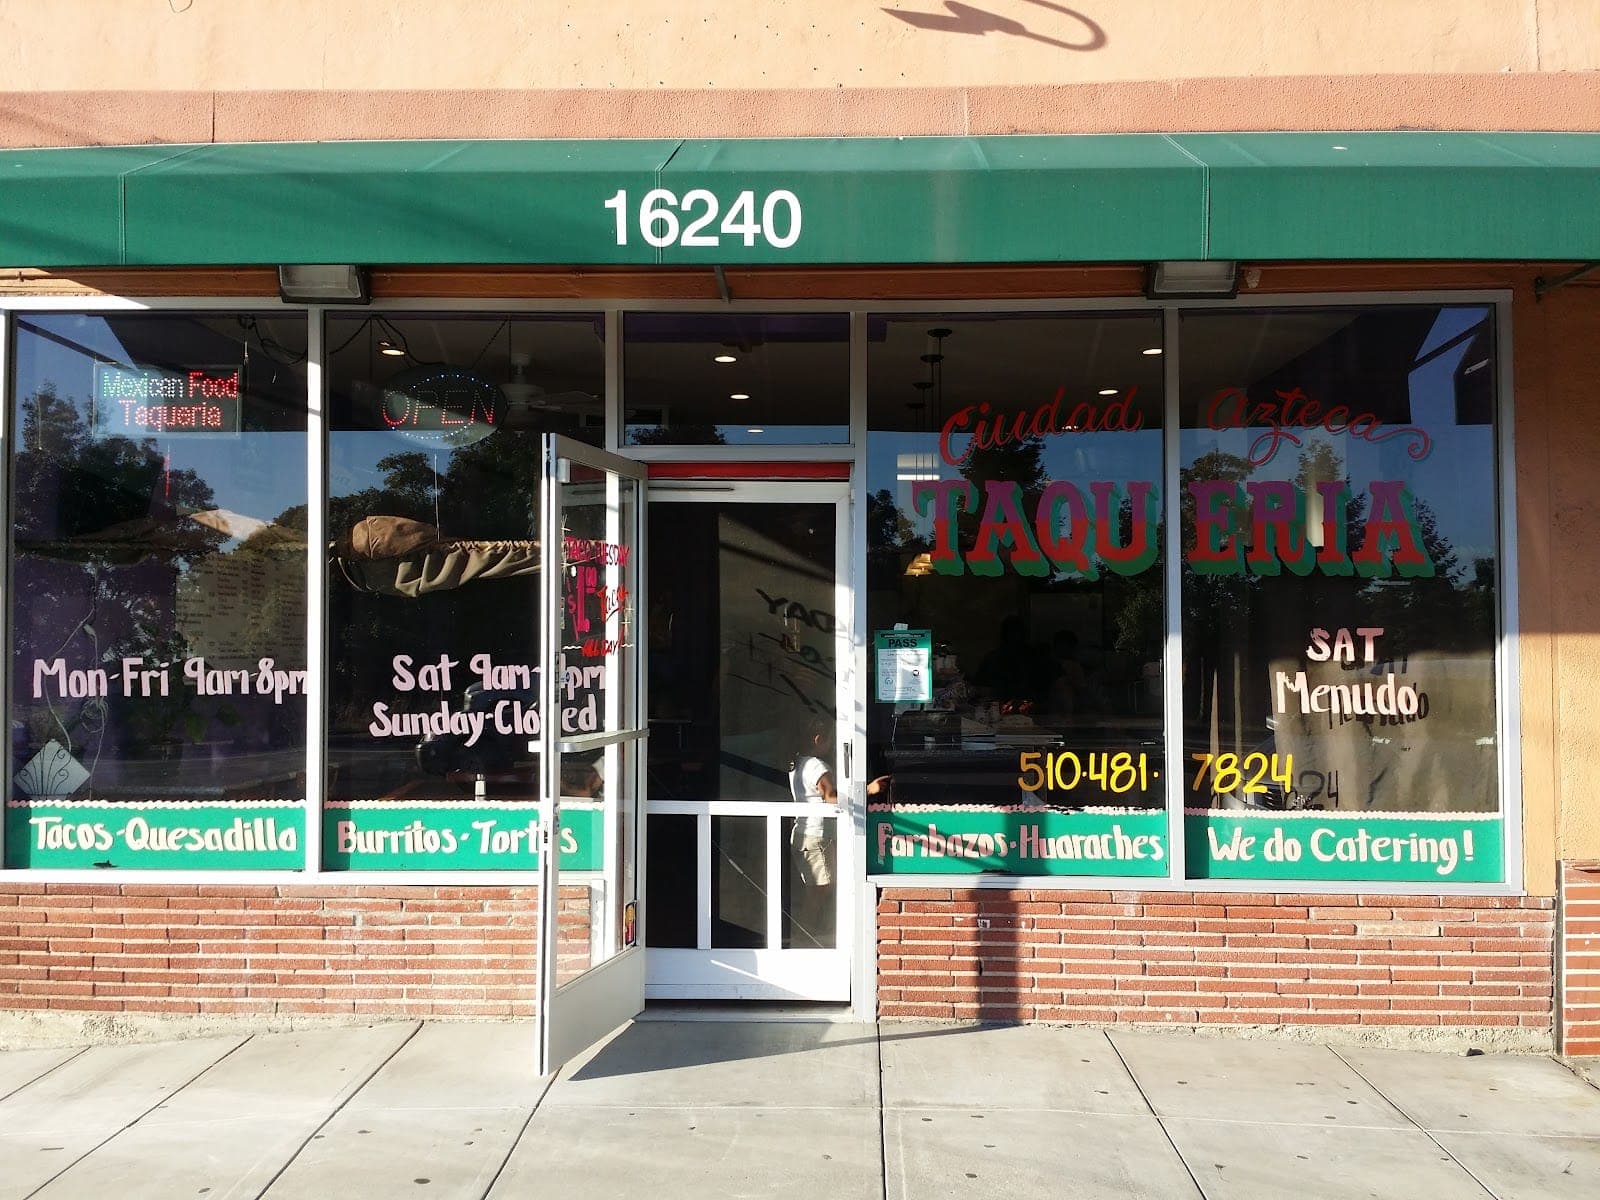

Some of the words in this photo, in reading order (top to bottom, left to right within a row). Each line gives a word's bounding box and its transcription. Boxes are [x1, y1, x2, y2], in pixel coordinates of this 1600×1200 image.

[604, 188, 802, 248] 16240
[103, 371, 184, 398] Mexican
[188, 371, 239, 398] Food
[382, 388, 497, 425] OPEN
[118, 399, 222, 432] Taqueria
[938, 386, 1143, 467] Ciudad
[1206, 387, 1433, 466] Azteca
[912, 480, 1436, 580] TAQUERIA
[888, 639, 918, 648] PASS
[1306, 627, 1385, 662] SAT
[33, 658, 169, 699] Mon-Fri
[183, 656, 308, 704] 9am-8pm
[393, 654, 458, 692] Sat
[469, 653, 606, 701] 9am-pm
[1275, 671, 1419, 715] Menudo
[368, 692, 598, 748] Sunday-Cloed
[1207, 826, 1256, 862] We
[1263, 827, 1301, 862] do
[1310, 828, 1474, 876] Catering!
